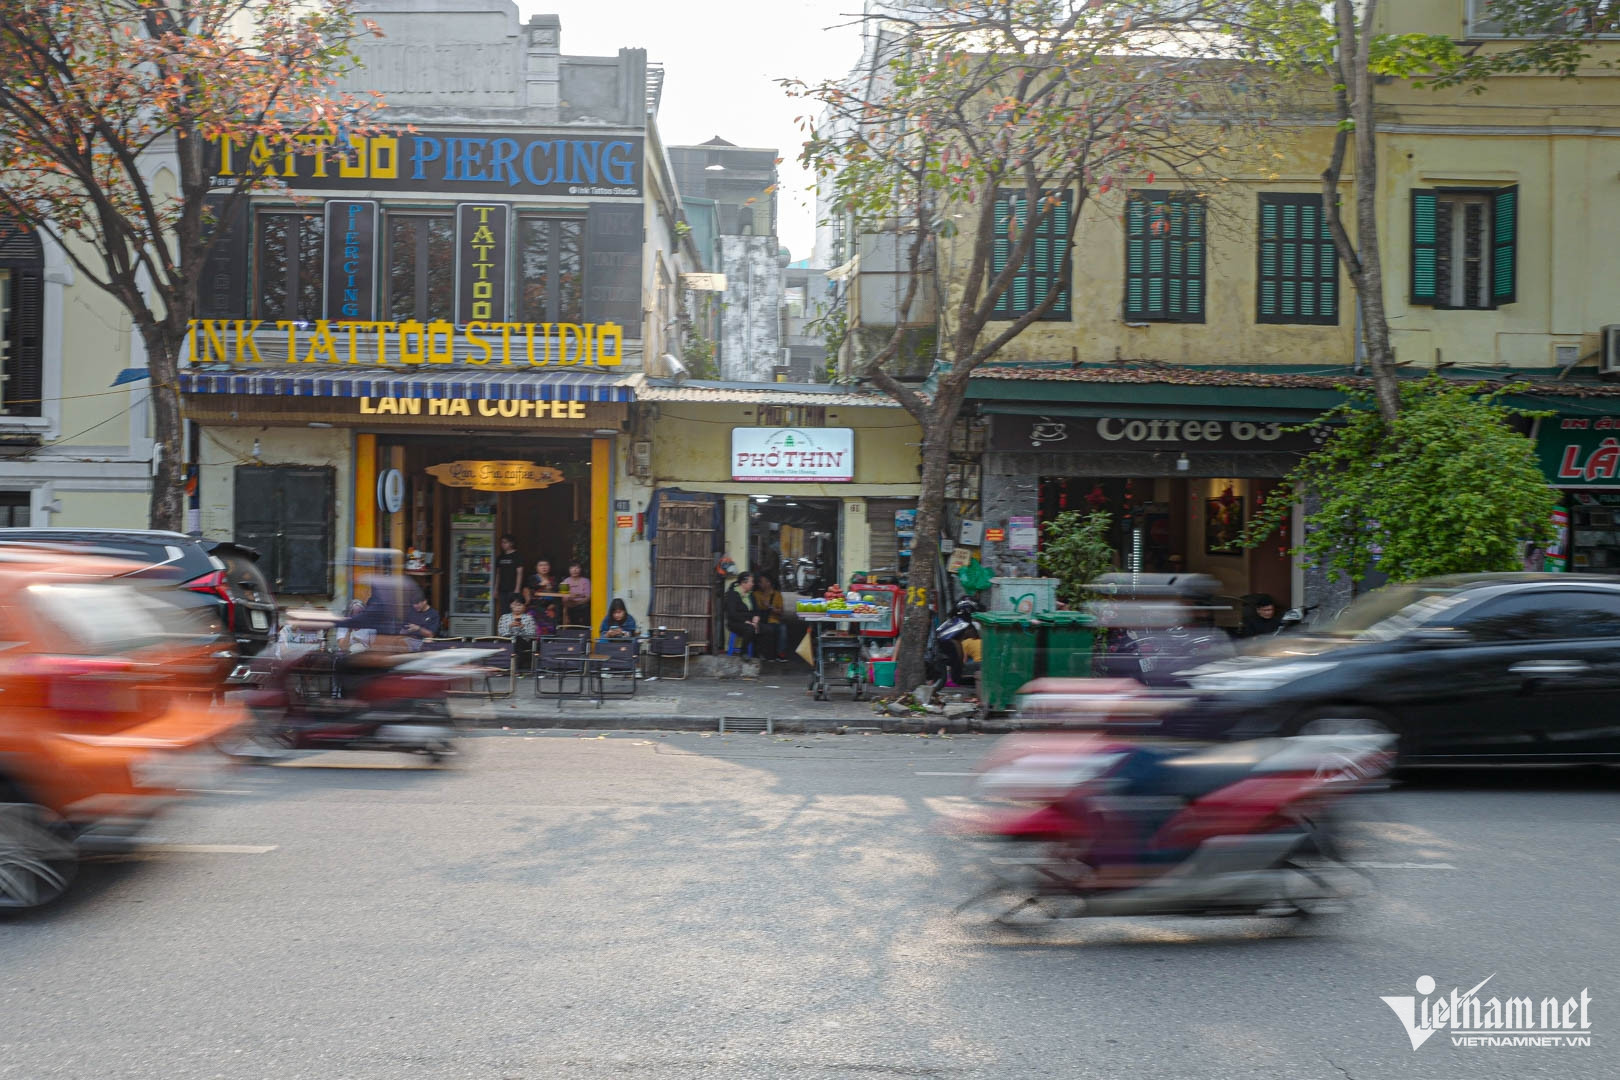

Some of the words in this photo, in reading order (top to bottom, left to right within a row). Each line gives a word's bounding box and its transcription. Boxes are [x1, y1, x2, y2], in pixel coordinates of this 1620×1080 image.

[209, 132, 398, 179] TATTOO
[409, 136, 636, 187] PIERCING
[342, 204, 364, 317] PIERCING
[470, 207, 496, 319] TATTOO
[187, 319, 264, 362] INK
[275, 319, 453, 364] TATTOO
[464, 320, 623, 367] STUDIO
[359, 396, 421, 415] LAN
[428, 398, 471, 416] HA
[478, 399, 586, 419] COFFEE
[1096, 417, 1223, 442] Coffee
[1230, 421, 1282, 442] 63
[737, 446, 781, 467] PHỞ
[783, 446, 843, 468] THÌN
[1557, 436, 1620, 482] LÂ
